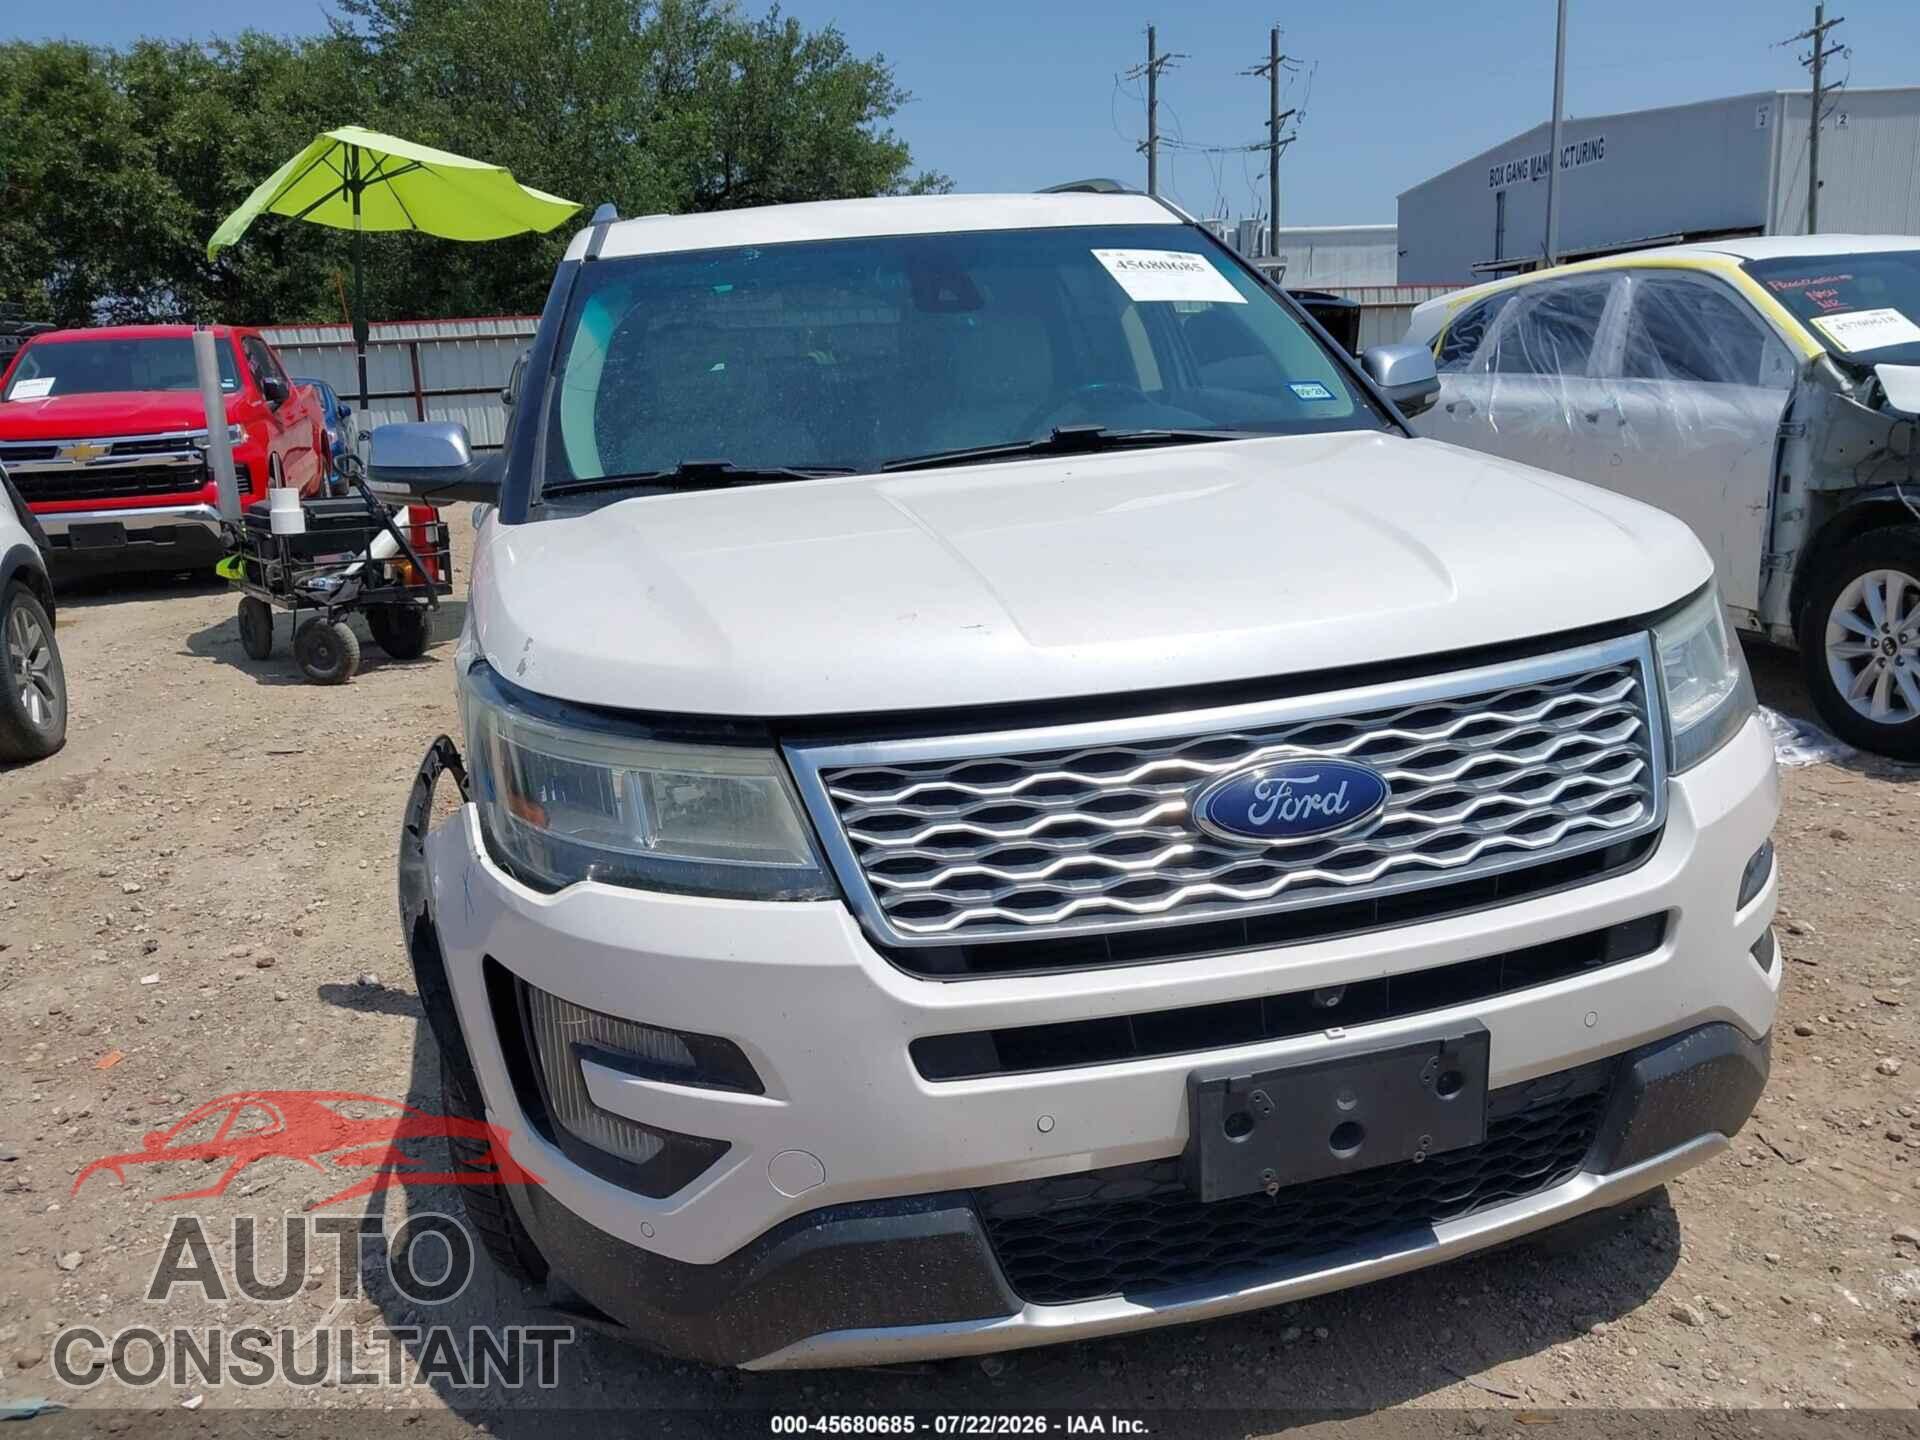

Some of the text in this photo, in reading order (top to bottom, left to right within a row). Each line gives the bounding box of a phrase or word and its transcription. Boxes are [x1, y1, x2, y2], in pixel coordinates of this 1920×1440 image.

[1840, 113, 1848, 125] 2
[1489, 167, 1505, 188] BOX
[1505, 159, 1529, 184] GANG
[1247, 774, 1350, 826] Ford
